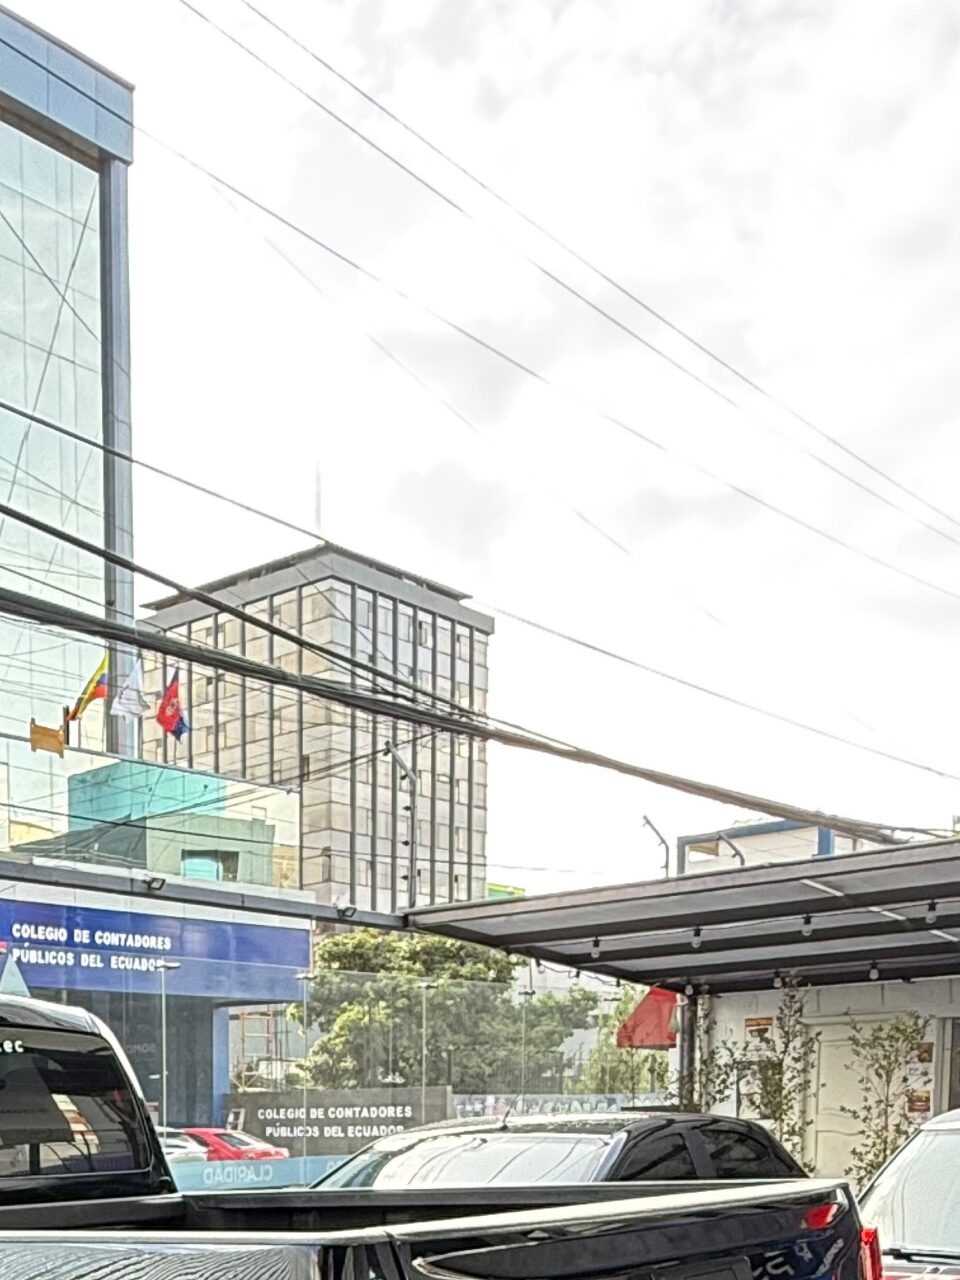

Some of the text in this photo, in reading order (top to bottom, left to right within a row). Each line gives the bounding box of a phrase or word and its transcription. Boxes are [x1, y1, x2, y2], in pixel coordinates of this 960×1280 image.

[12, 923, 171, 950] COLEGIO DE CONTADORES
[12, 942, 74, 966] PÚBLICOS
[81, 954, 104, 968] DEL
[257, 1105, 413, 1120] COLEGIO DE CONTADORES
[265, 1122, 320, 1137] PÚBLICOS
[324, 1126, 344, 1137] DEL
